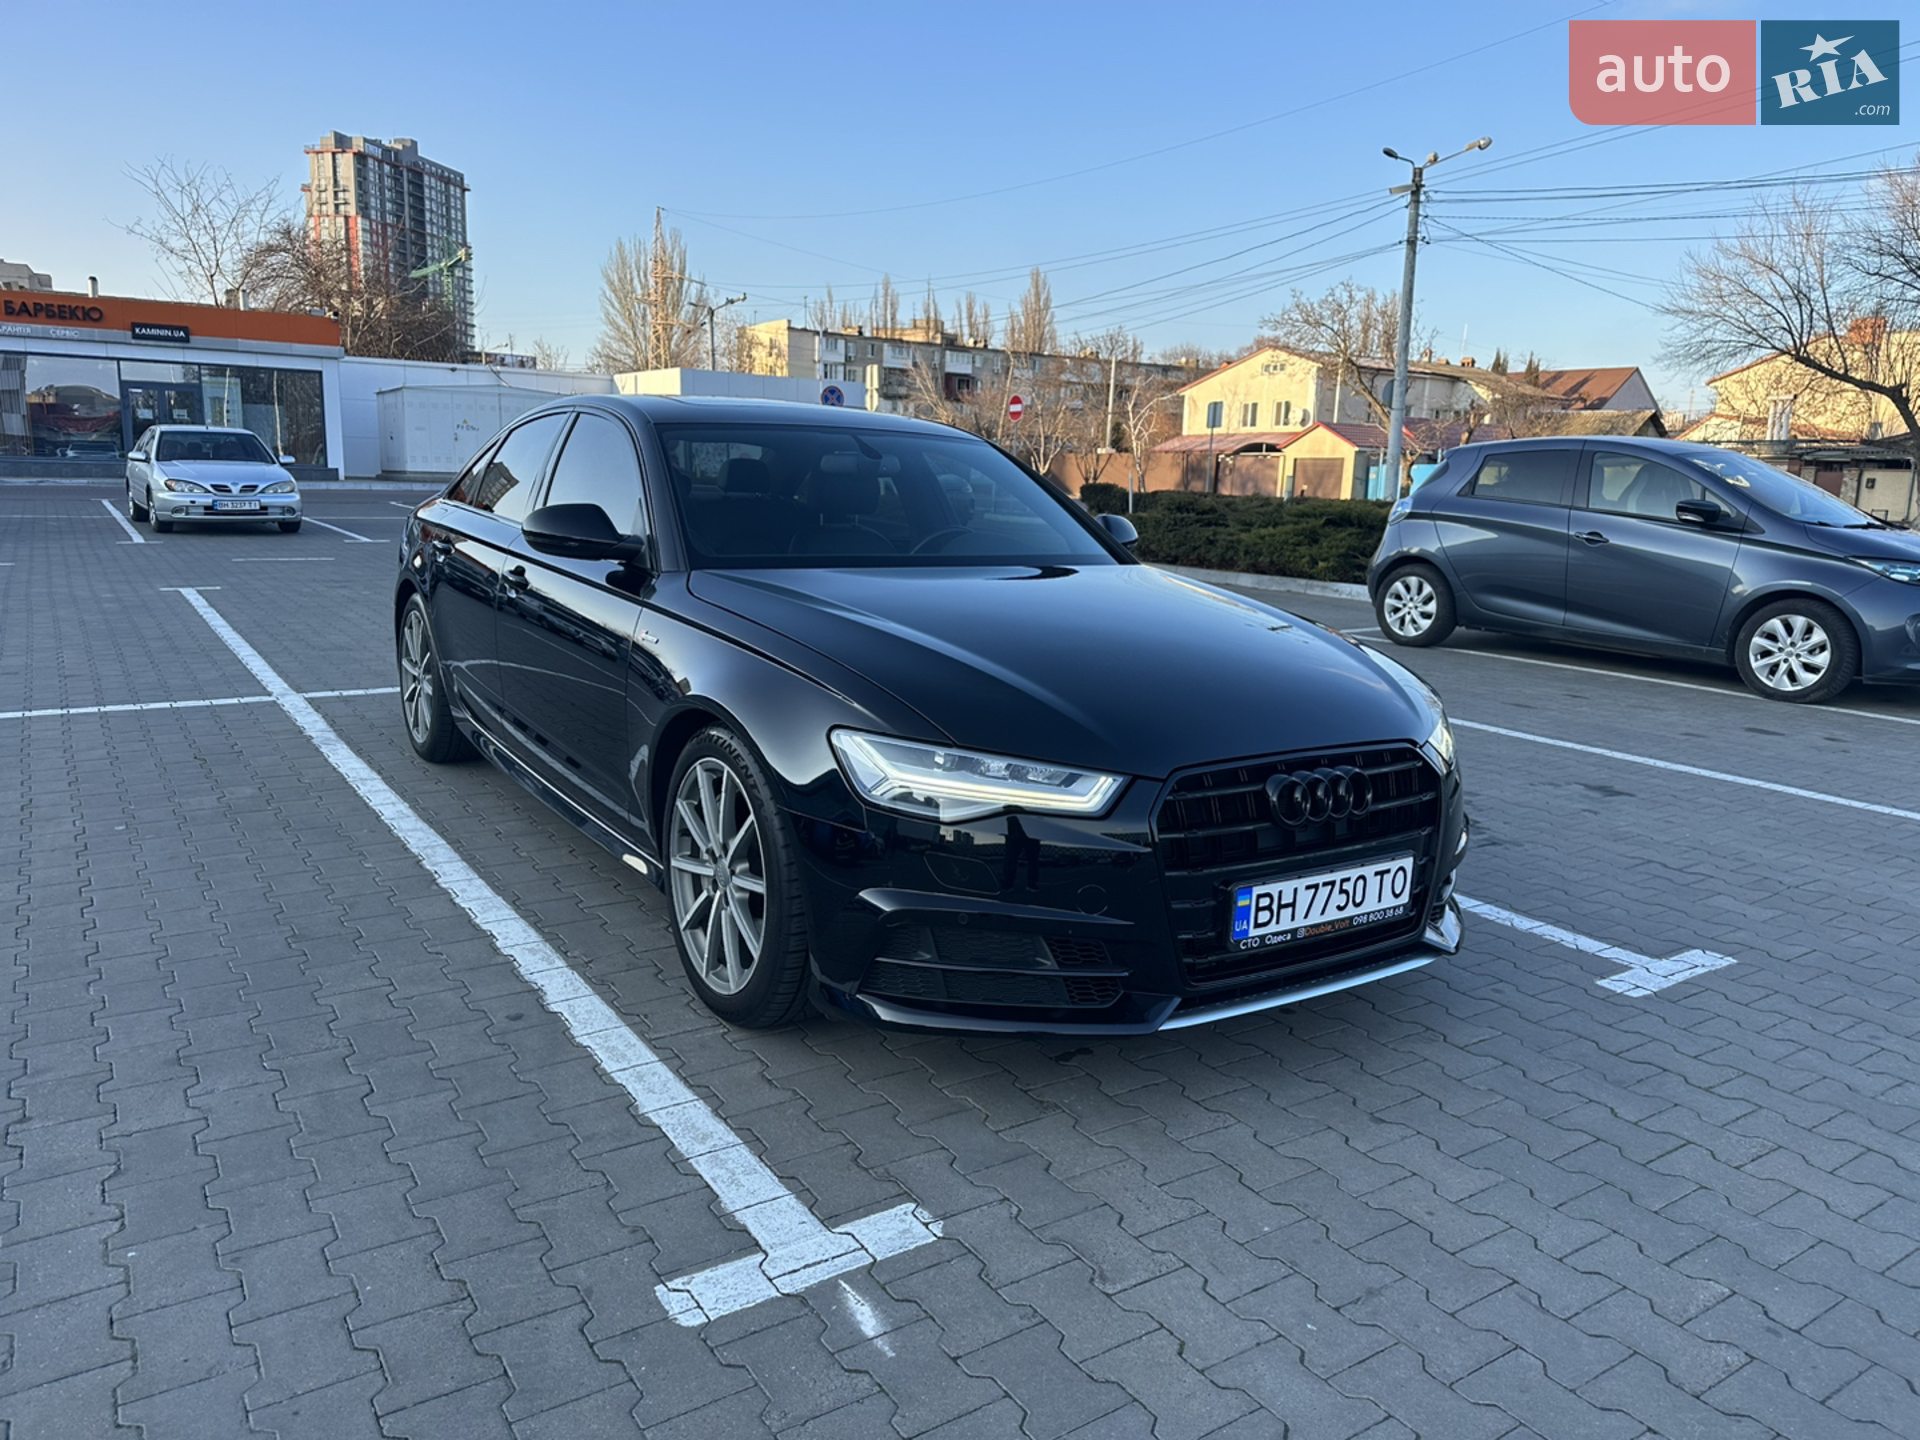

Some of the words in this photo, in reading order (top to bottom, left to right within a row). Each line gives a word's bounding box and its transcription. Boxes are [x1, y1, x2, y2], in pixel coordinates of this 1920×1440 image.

[3, 299, 104, 323] БАРБЕКЮ
[0, 325, 32, 334] РАНТІЯ
[134, 326, 186, 338] KAMININ.UA
[1253, 887, 1298, 929] BH
[1303, 874, 1367, 920] 7750
[1374, 865, 1408, 904] TO
[1234, 920, 1248, 932] UA
[1240, 937, 1260, 949] СТО
[1265, 932, 1291, 944] Одеса
[1352, 914, 1368, 925] 098
[1369, 909, 1384, 922] 800
